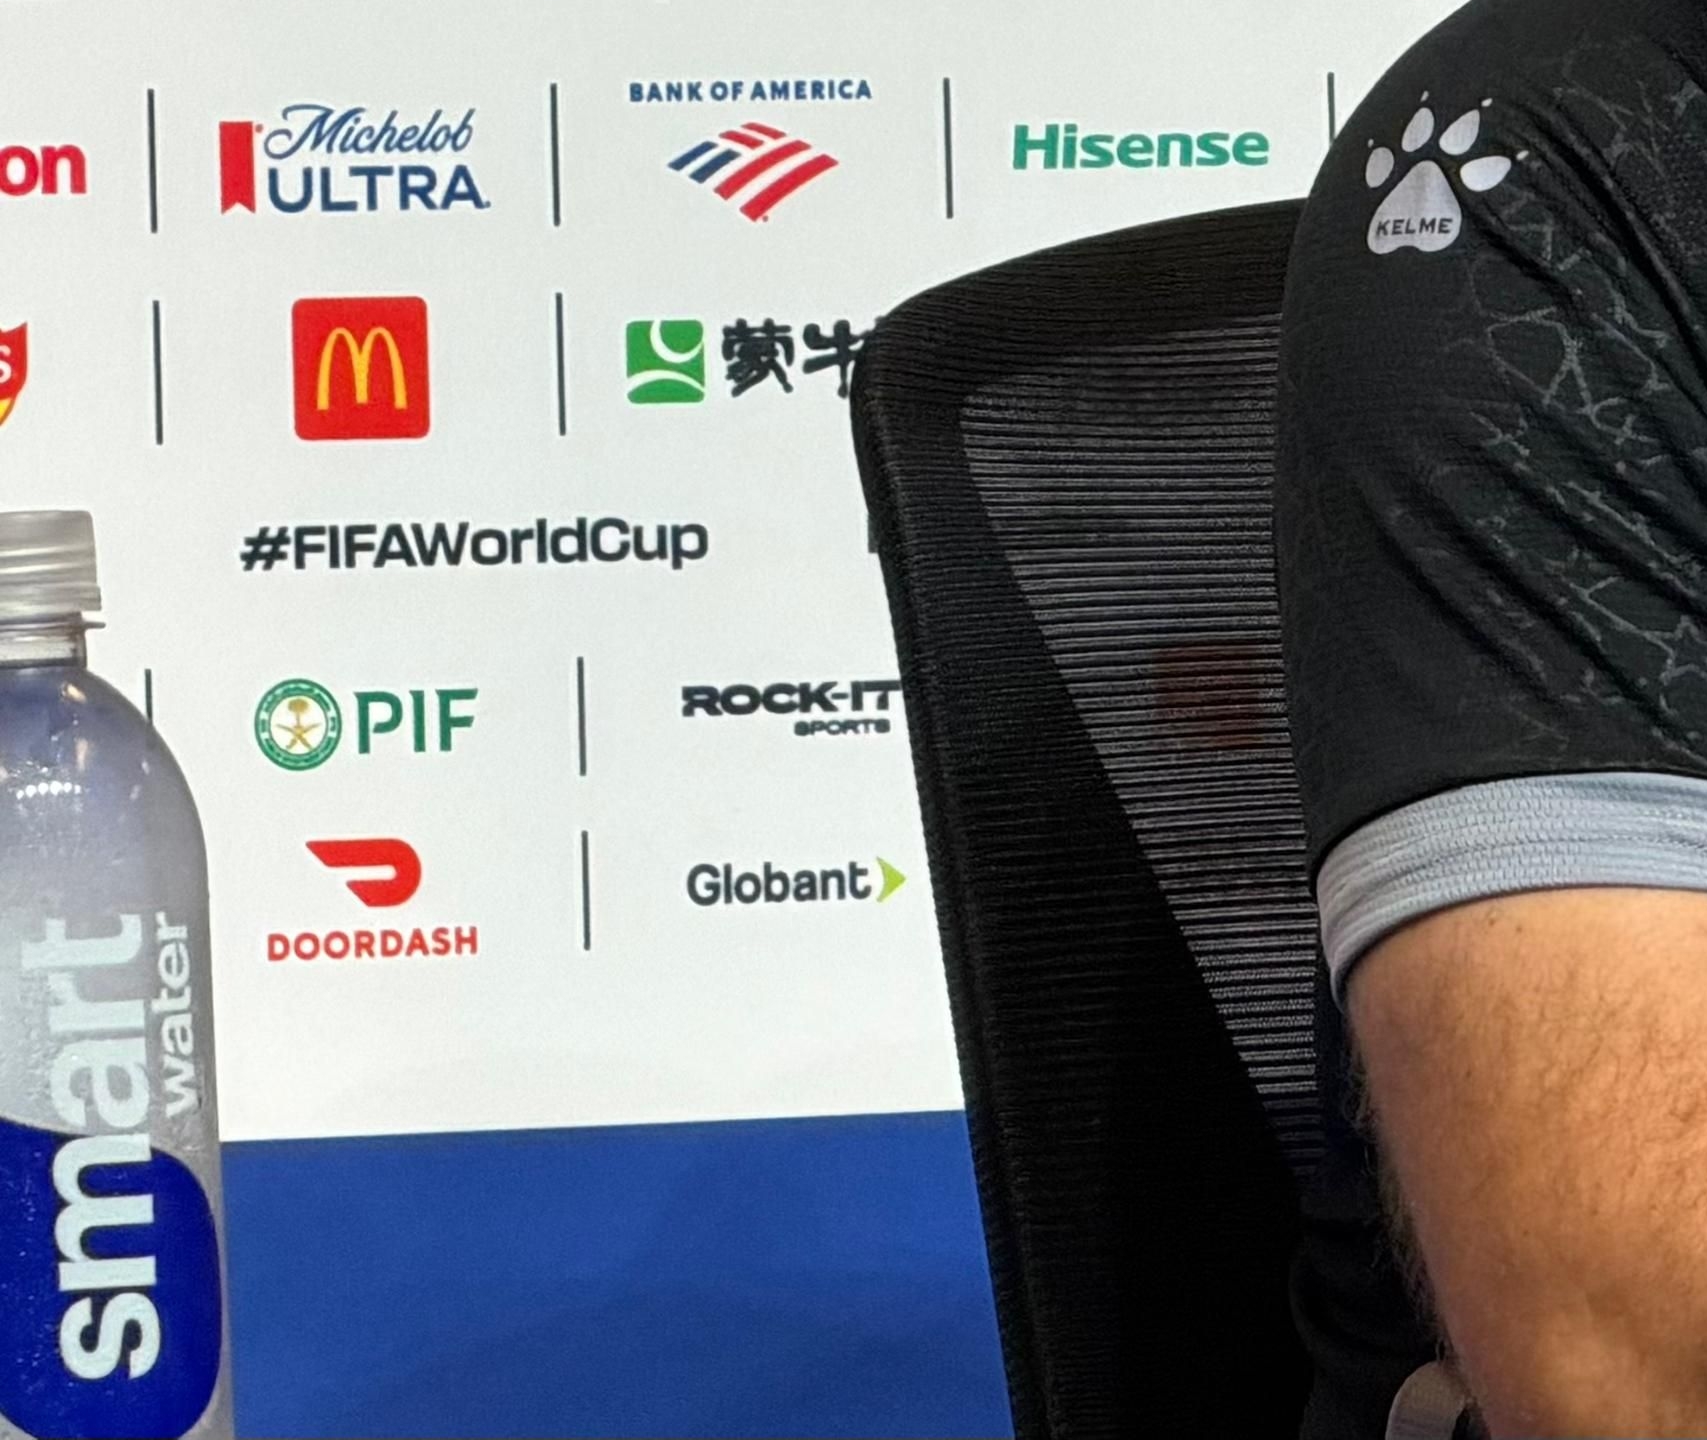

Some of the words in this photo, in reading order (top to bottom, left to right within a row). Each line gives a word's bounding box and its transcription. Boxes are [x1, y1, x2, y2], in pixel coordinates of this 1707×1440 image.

[630, 82, 702, 102] BANK
[710, 81, 743, 101] OF
[751, 80, 871, 100] AMERICA
[264, 104, 475, 160] Michelob
[1013, 124, 1269, 169] Hisense
[269, 165, 490, 213] ULTRA
[1376, 217, 1453, 236] KELME
[240, 517, 708, 571] #FIFAWorldCup
[682, 680, 902, 717] ROCK-IT
[355, 689, 477, 754] PIF
[794, 719, 890, 736] SPORTS
[687, 862, 871, 906] Globant
[268, 927, 477, 961] DOORDASH
[151, 912, 200, 1118] water
[21, 912, 161, 1381] smart
